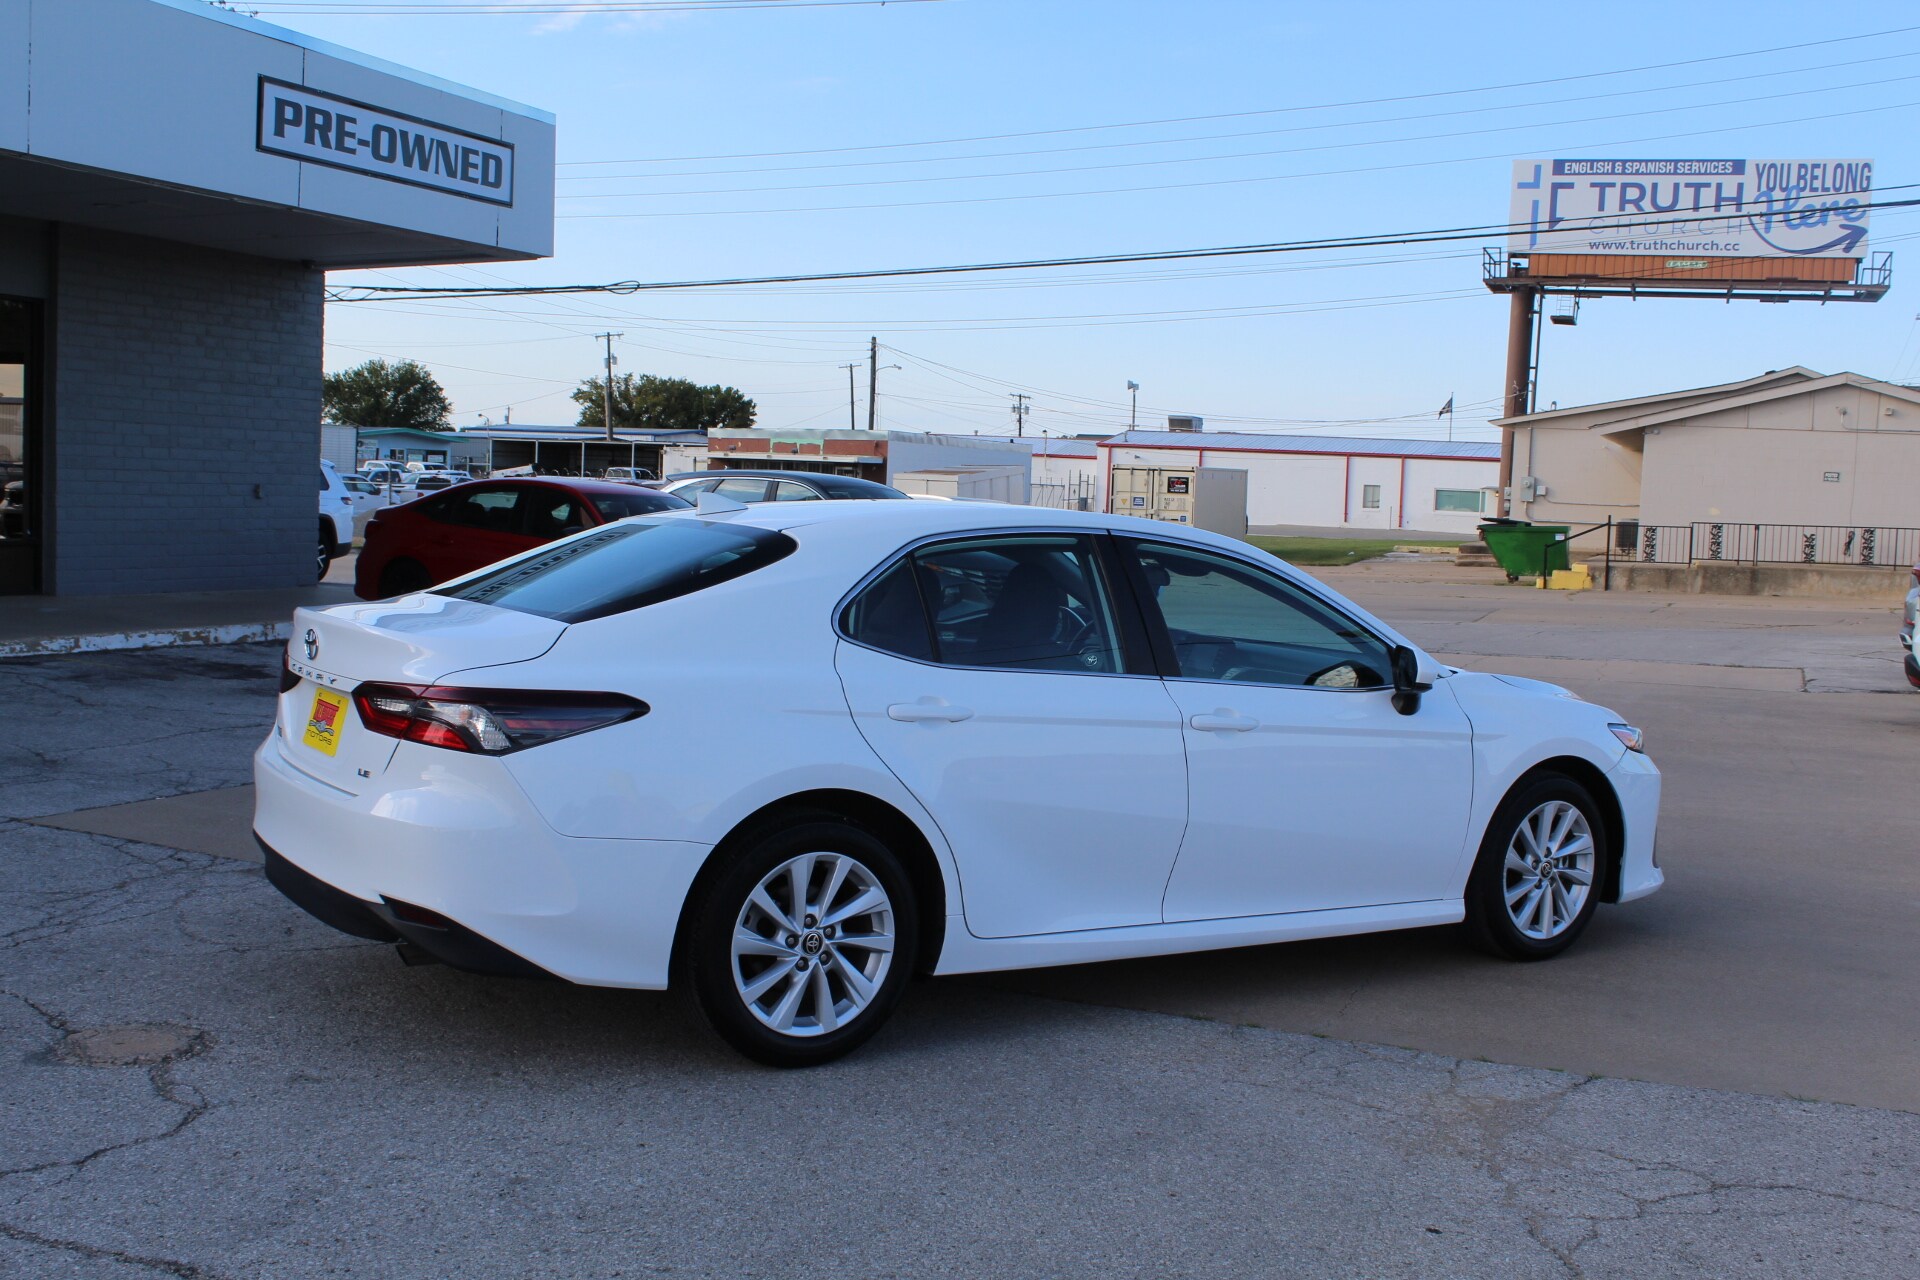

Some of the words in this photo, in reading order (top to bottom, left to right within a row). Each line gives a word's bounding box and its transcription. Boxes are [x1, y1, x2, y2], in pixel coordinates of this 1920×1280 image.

[273, 96, 503, 189] PRE-OWNED
[1564, 161, 1612, 174] ENGLISH
[1614, 161, 1623, 174] &
[1624, 161, 1675, 174] SPANISH
[1676, 161, 1734, 174] SERVICES
[1755, 162, 1792, 193] YOU
[1796, 162, 1872, 193] BELONG
[1589, 182, 1745, 213] TRUTH
[1753, 184, 1867, 234] Here
[1588, 217, 1743, 236] CHURCH
[1588, 239, 1740, 251] www.truthchurch.cc
[358, 767, 371, 779] LE
